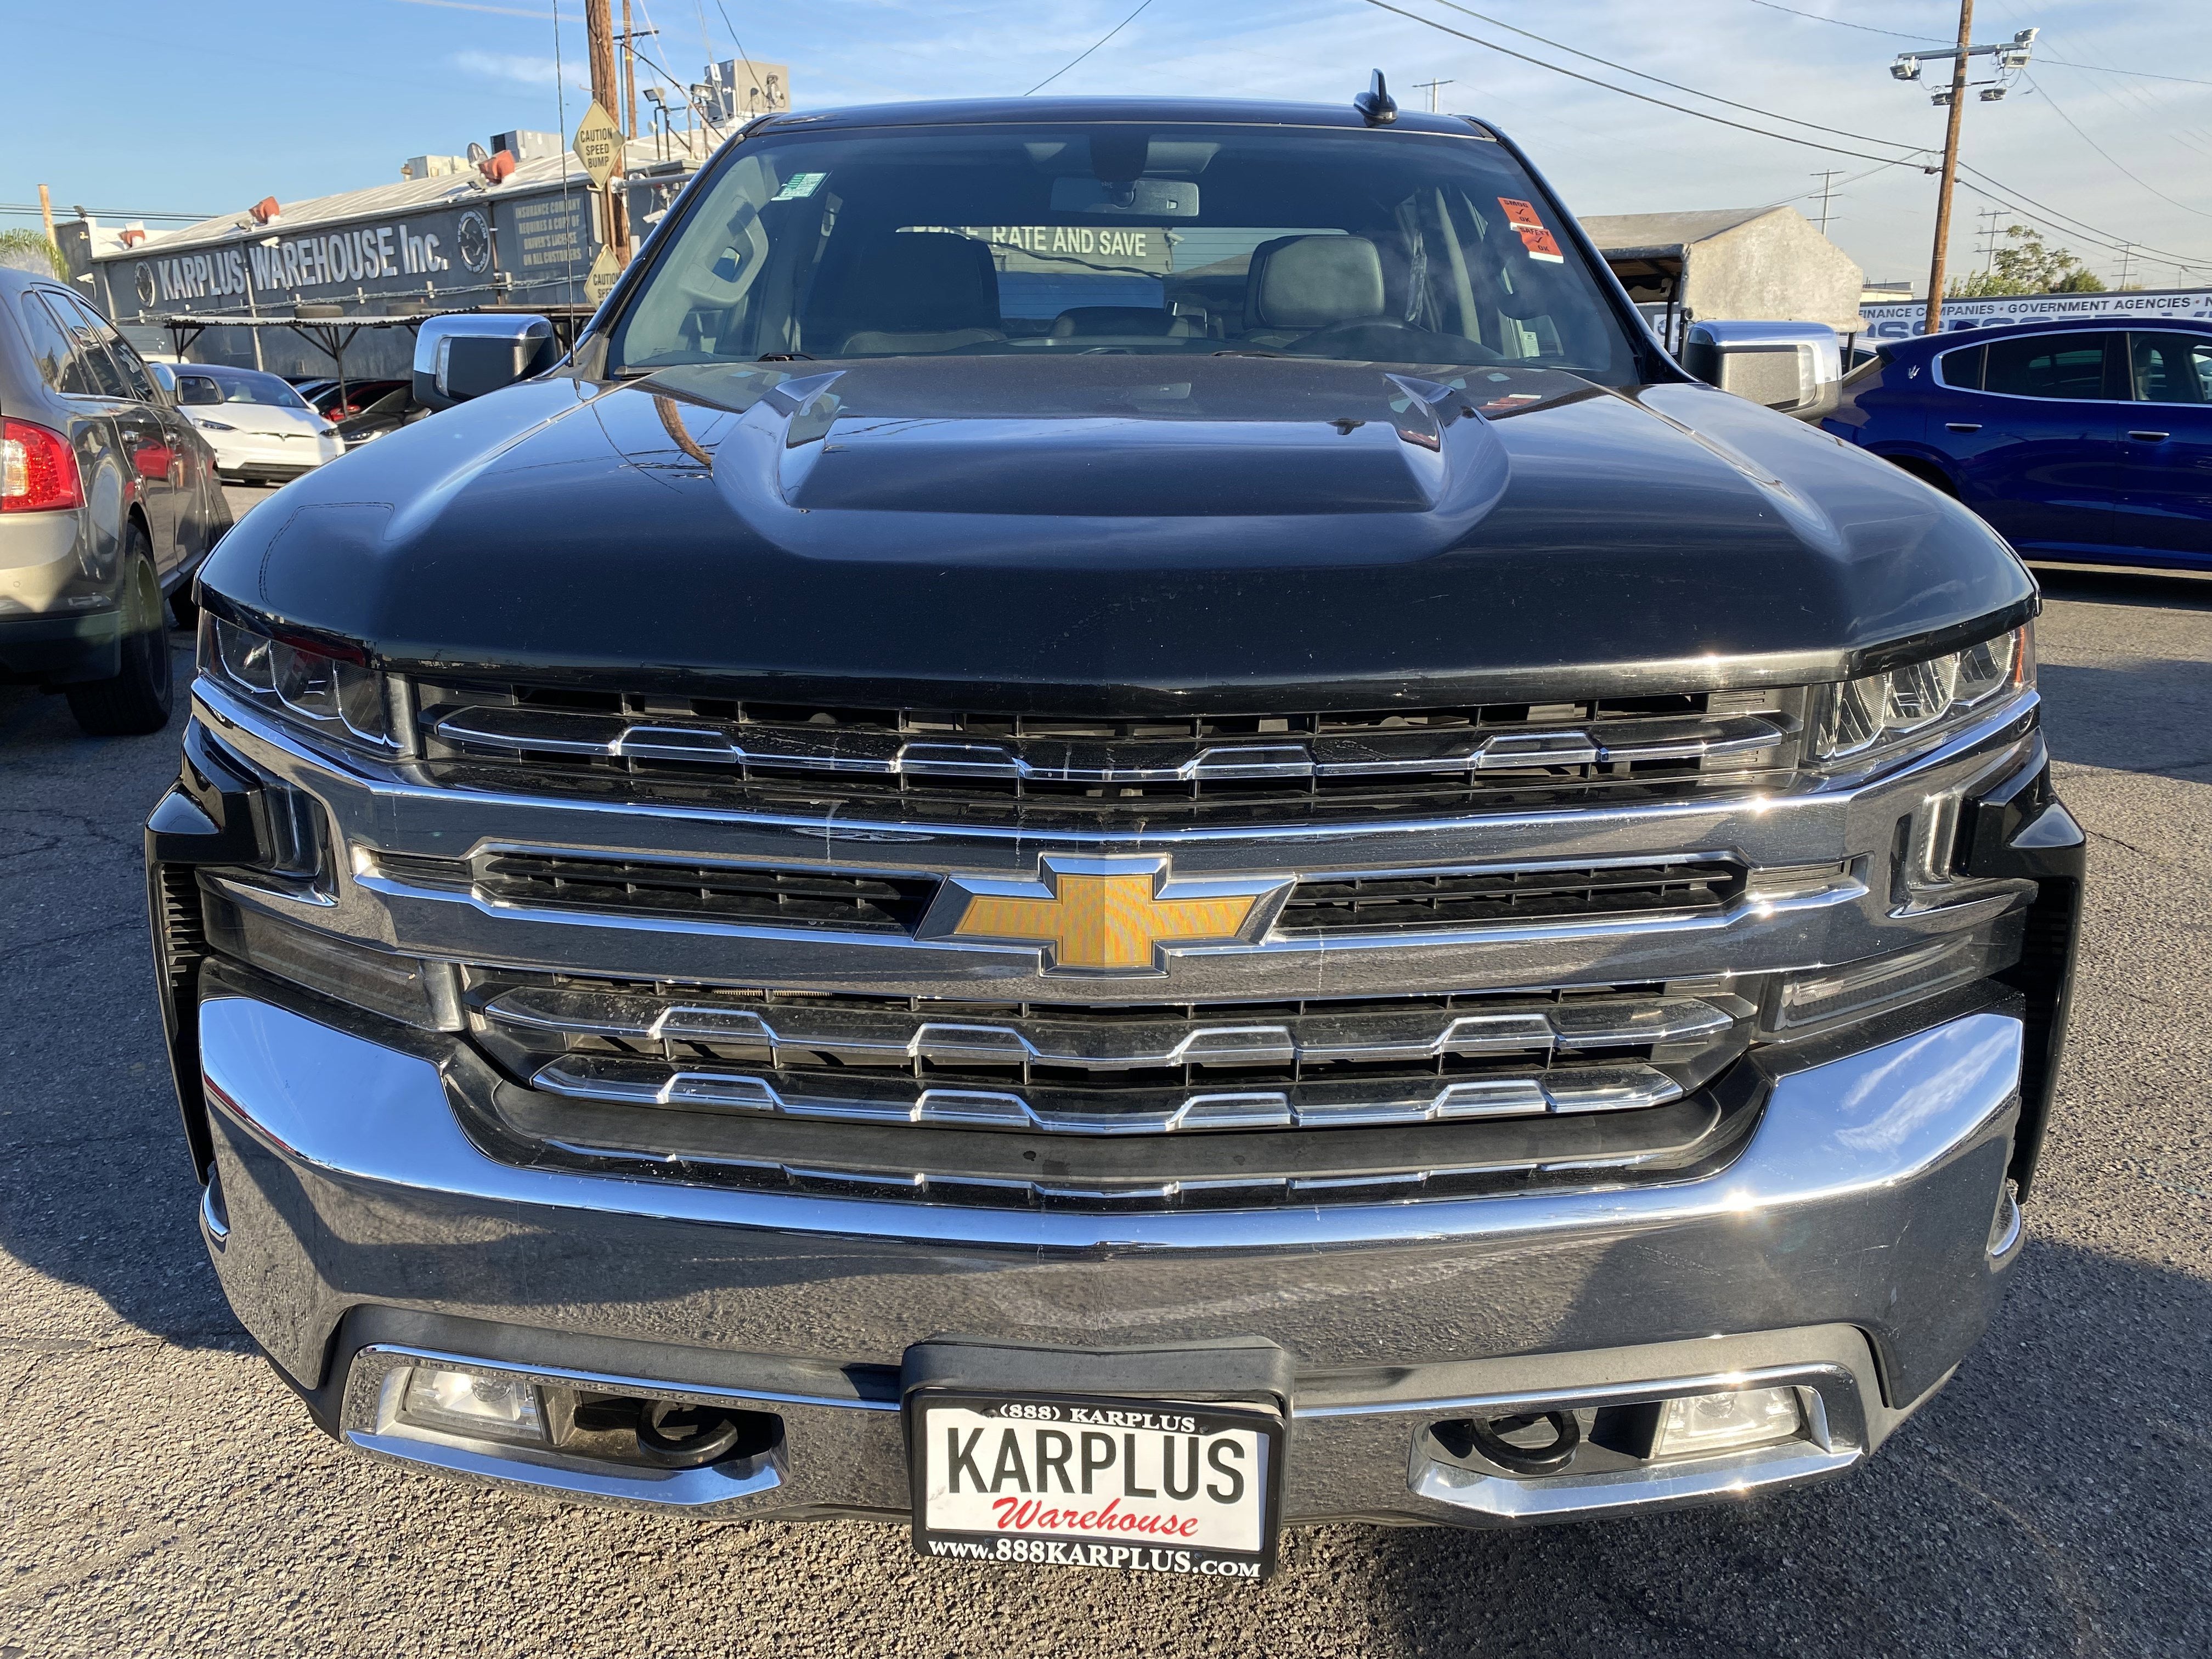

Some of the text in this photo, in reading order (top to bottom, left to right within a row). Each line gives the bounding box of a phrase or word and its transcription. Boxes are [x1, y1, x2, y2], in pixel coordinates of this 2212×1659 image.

[580, 127, 613, 143] CAUTION
[586, 143, 609, 156] SPEED
[588, 156, 609, 168] BUMP
[548, 219, 553, 230] A
[1520, 228, 1549, 236] SAFETY
[992, 226, 1047, 251] RATE
[1053, 227, 1093, 254] AND
[1099, 230, 1147, 257] SAVE
[157, 250, 246, 301] KARPLUS
[248, 226, 398, 291] WAREHOUSE
[399, 224, 450, 274] Inc.
[524, 255, 532, 266] ON
[533, 252, 544, 265] ALL
[1858, 308, 1912, 318] FINANCE
[1916, 304, 1995, 318] CMPANIES
[2008, 300, 2110, 314] GOVERNMENT
[2113, 297, 2191, 310] AGENCIES
[1000, 1403, 1195, 1433] (888) KARPLUS
[947, 1427, 1245, 1504] KARPLUS
[992, 1496, 1200, 1538] Warehouse
